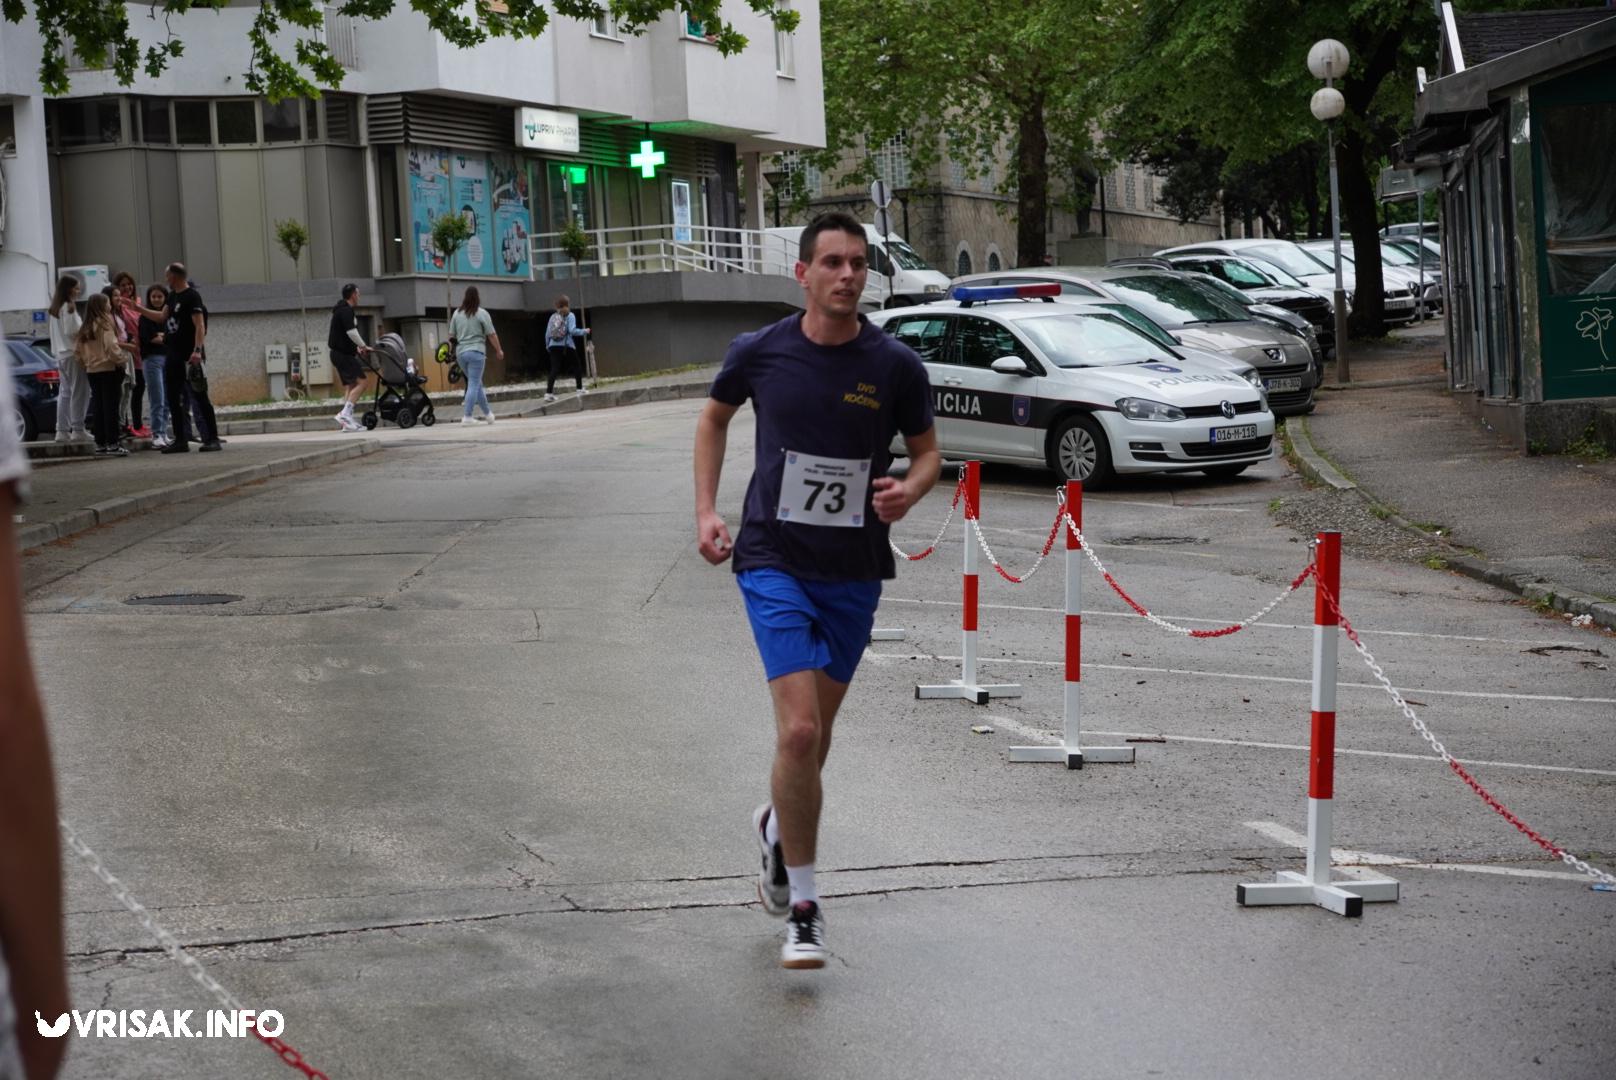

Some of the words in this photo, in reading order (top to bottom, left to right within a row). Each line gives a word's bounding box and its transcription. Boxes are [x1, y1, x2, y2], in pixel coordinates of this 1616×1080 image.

[857, 383, 876, 394] DVD
[1148, 375, 1241, 389] POLICIJA
[934, 392, 982, 415] ICIJA
[1216, 427, 1256, 440] 016-M-118
[803, 479, 847, 514] 73
